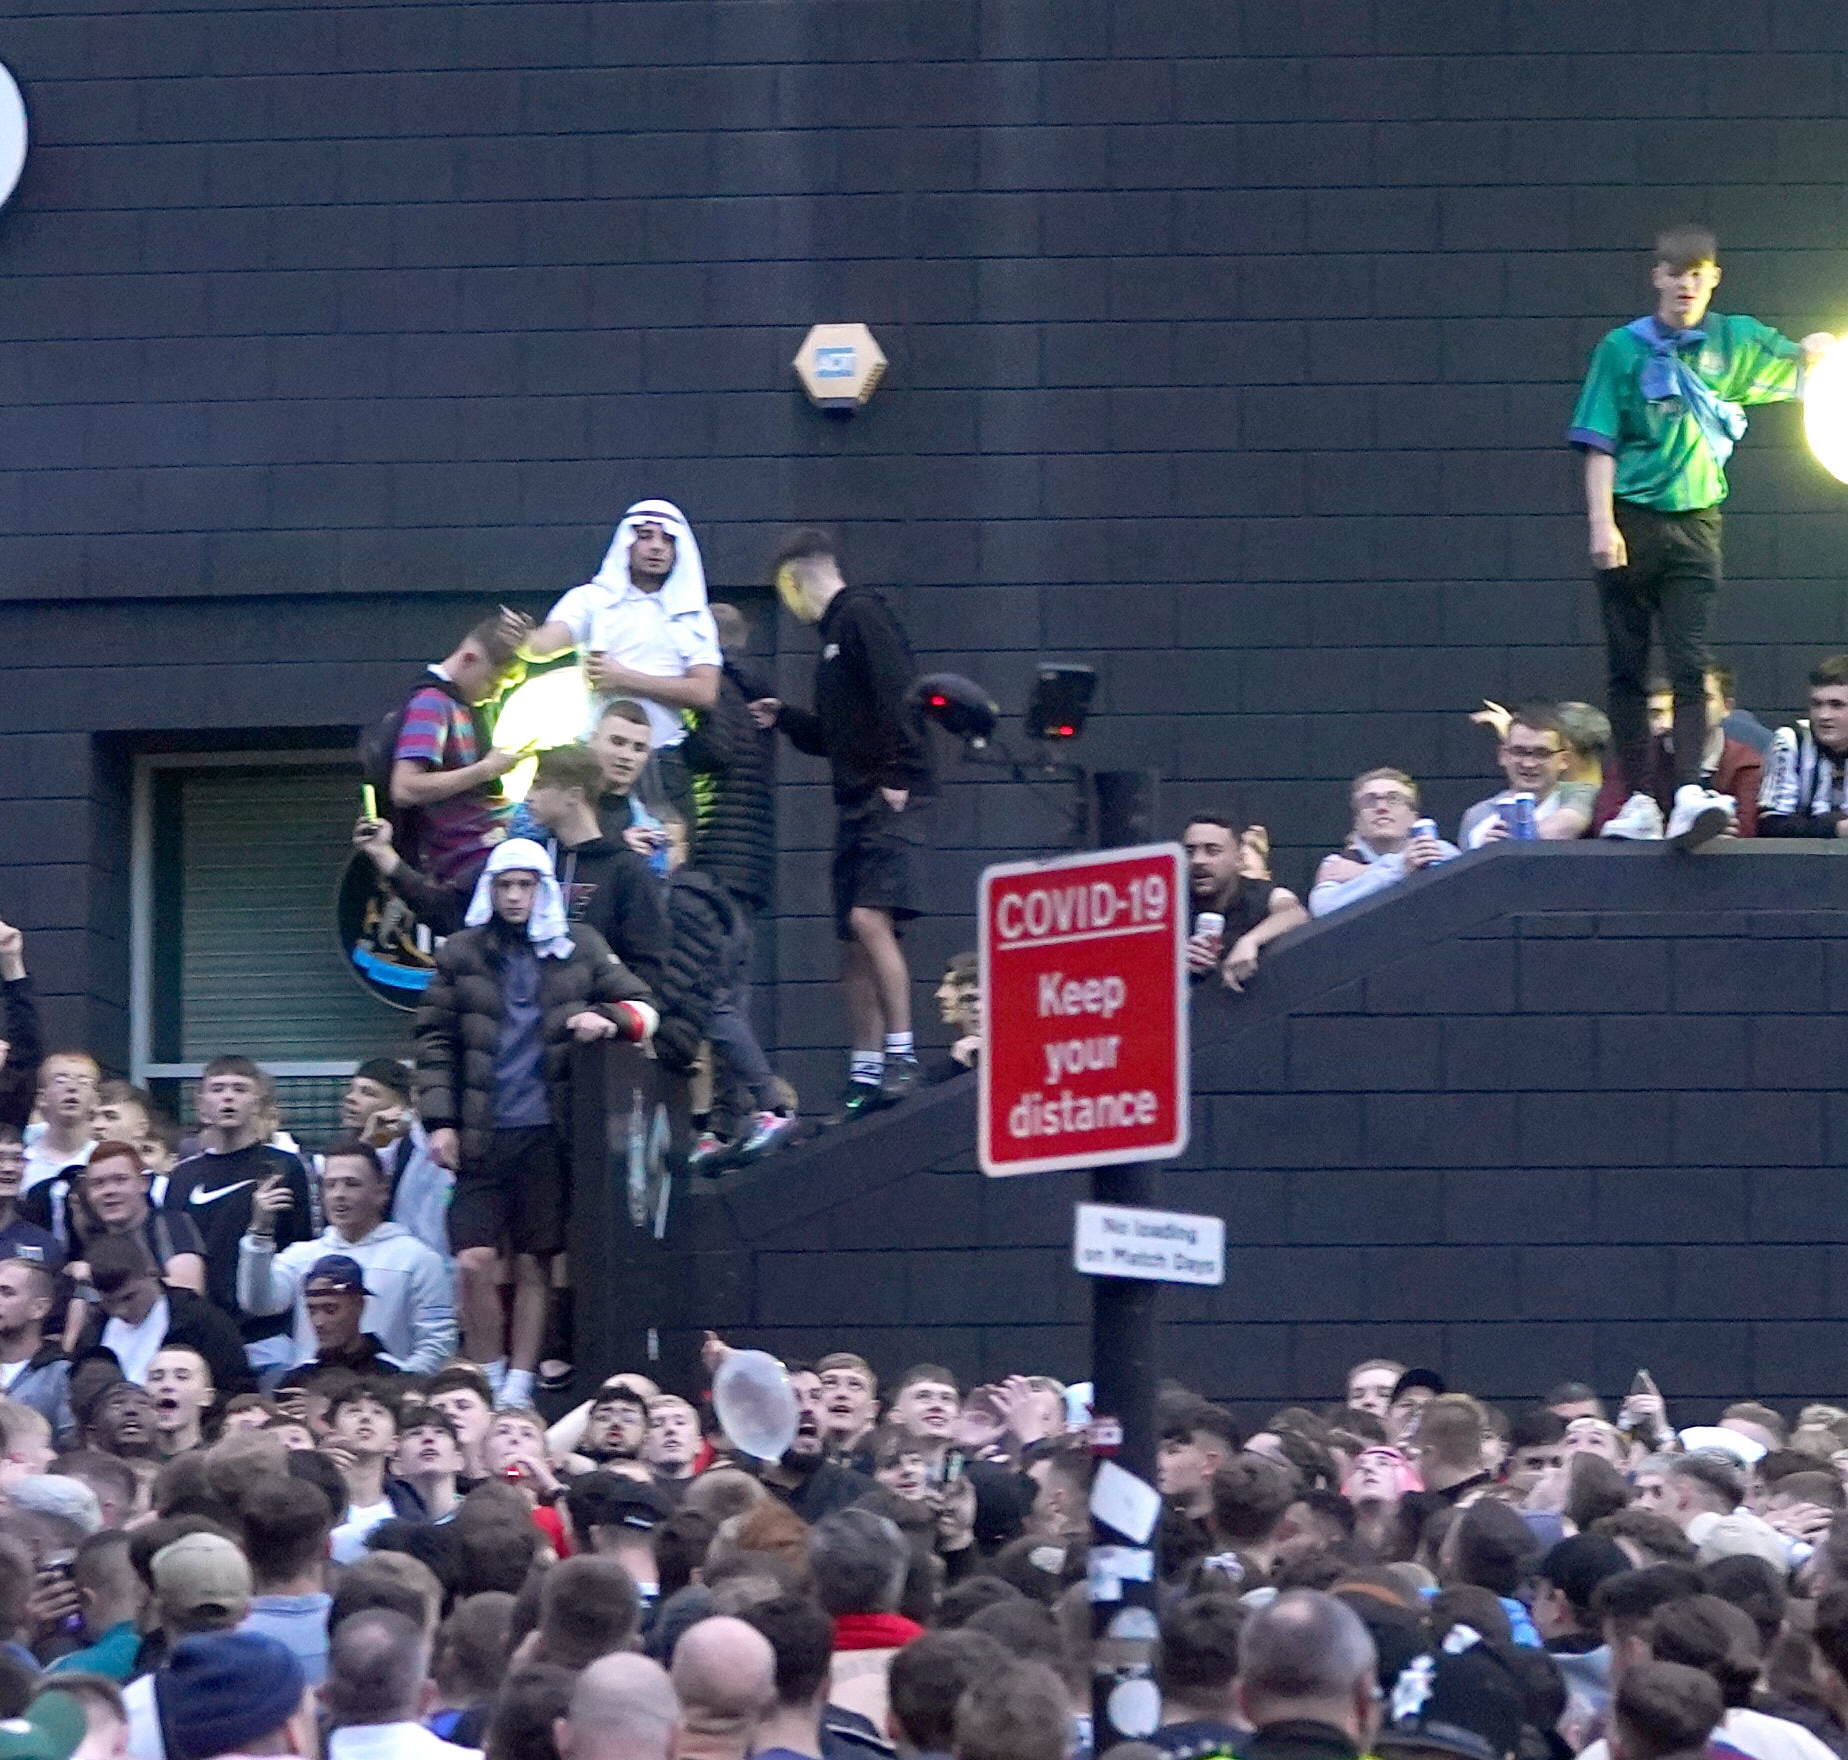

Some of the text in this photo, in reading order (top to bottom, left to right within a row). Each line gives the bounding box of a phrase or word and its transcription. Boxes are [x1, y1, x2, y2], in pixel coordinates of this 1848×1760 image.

[996, 874, 1169, 939] COVID-19
[1037, 971, 1127, 1019] Keep
[1043, 1035, 1122, 1086] your
[1008, 1090, 1159, 1139] distance
